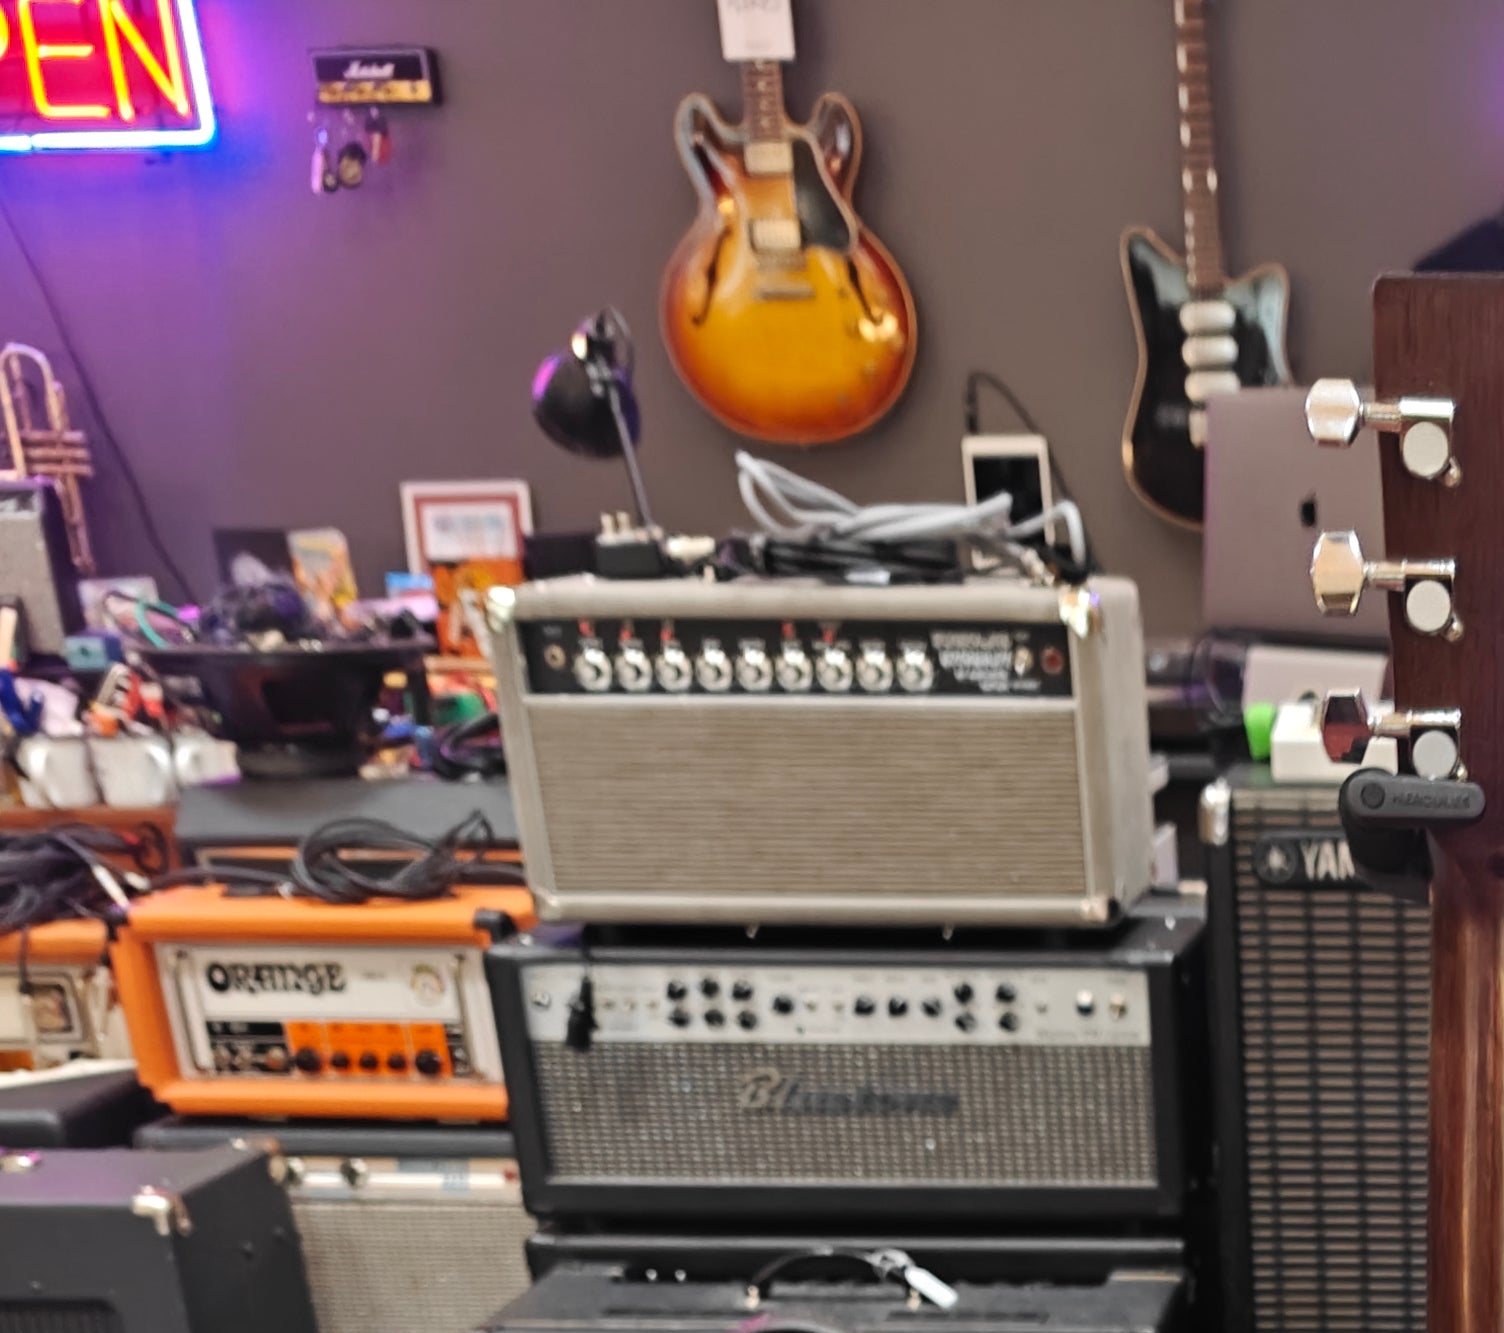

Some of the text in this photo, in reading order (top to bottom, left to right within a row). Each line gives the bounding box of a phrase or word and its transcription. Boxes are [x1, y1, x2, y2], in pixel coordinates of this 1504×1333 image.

[1393, 792, 1471, 810] HERCULES
[1301, 839, 1355, 881] YAM
[207, 961, 346, 996] ORANGE
